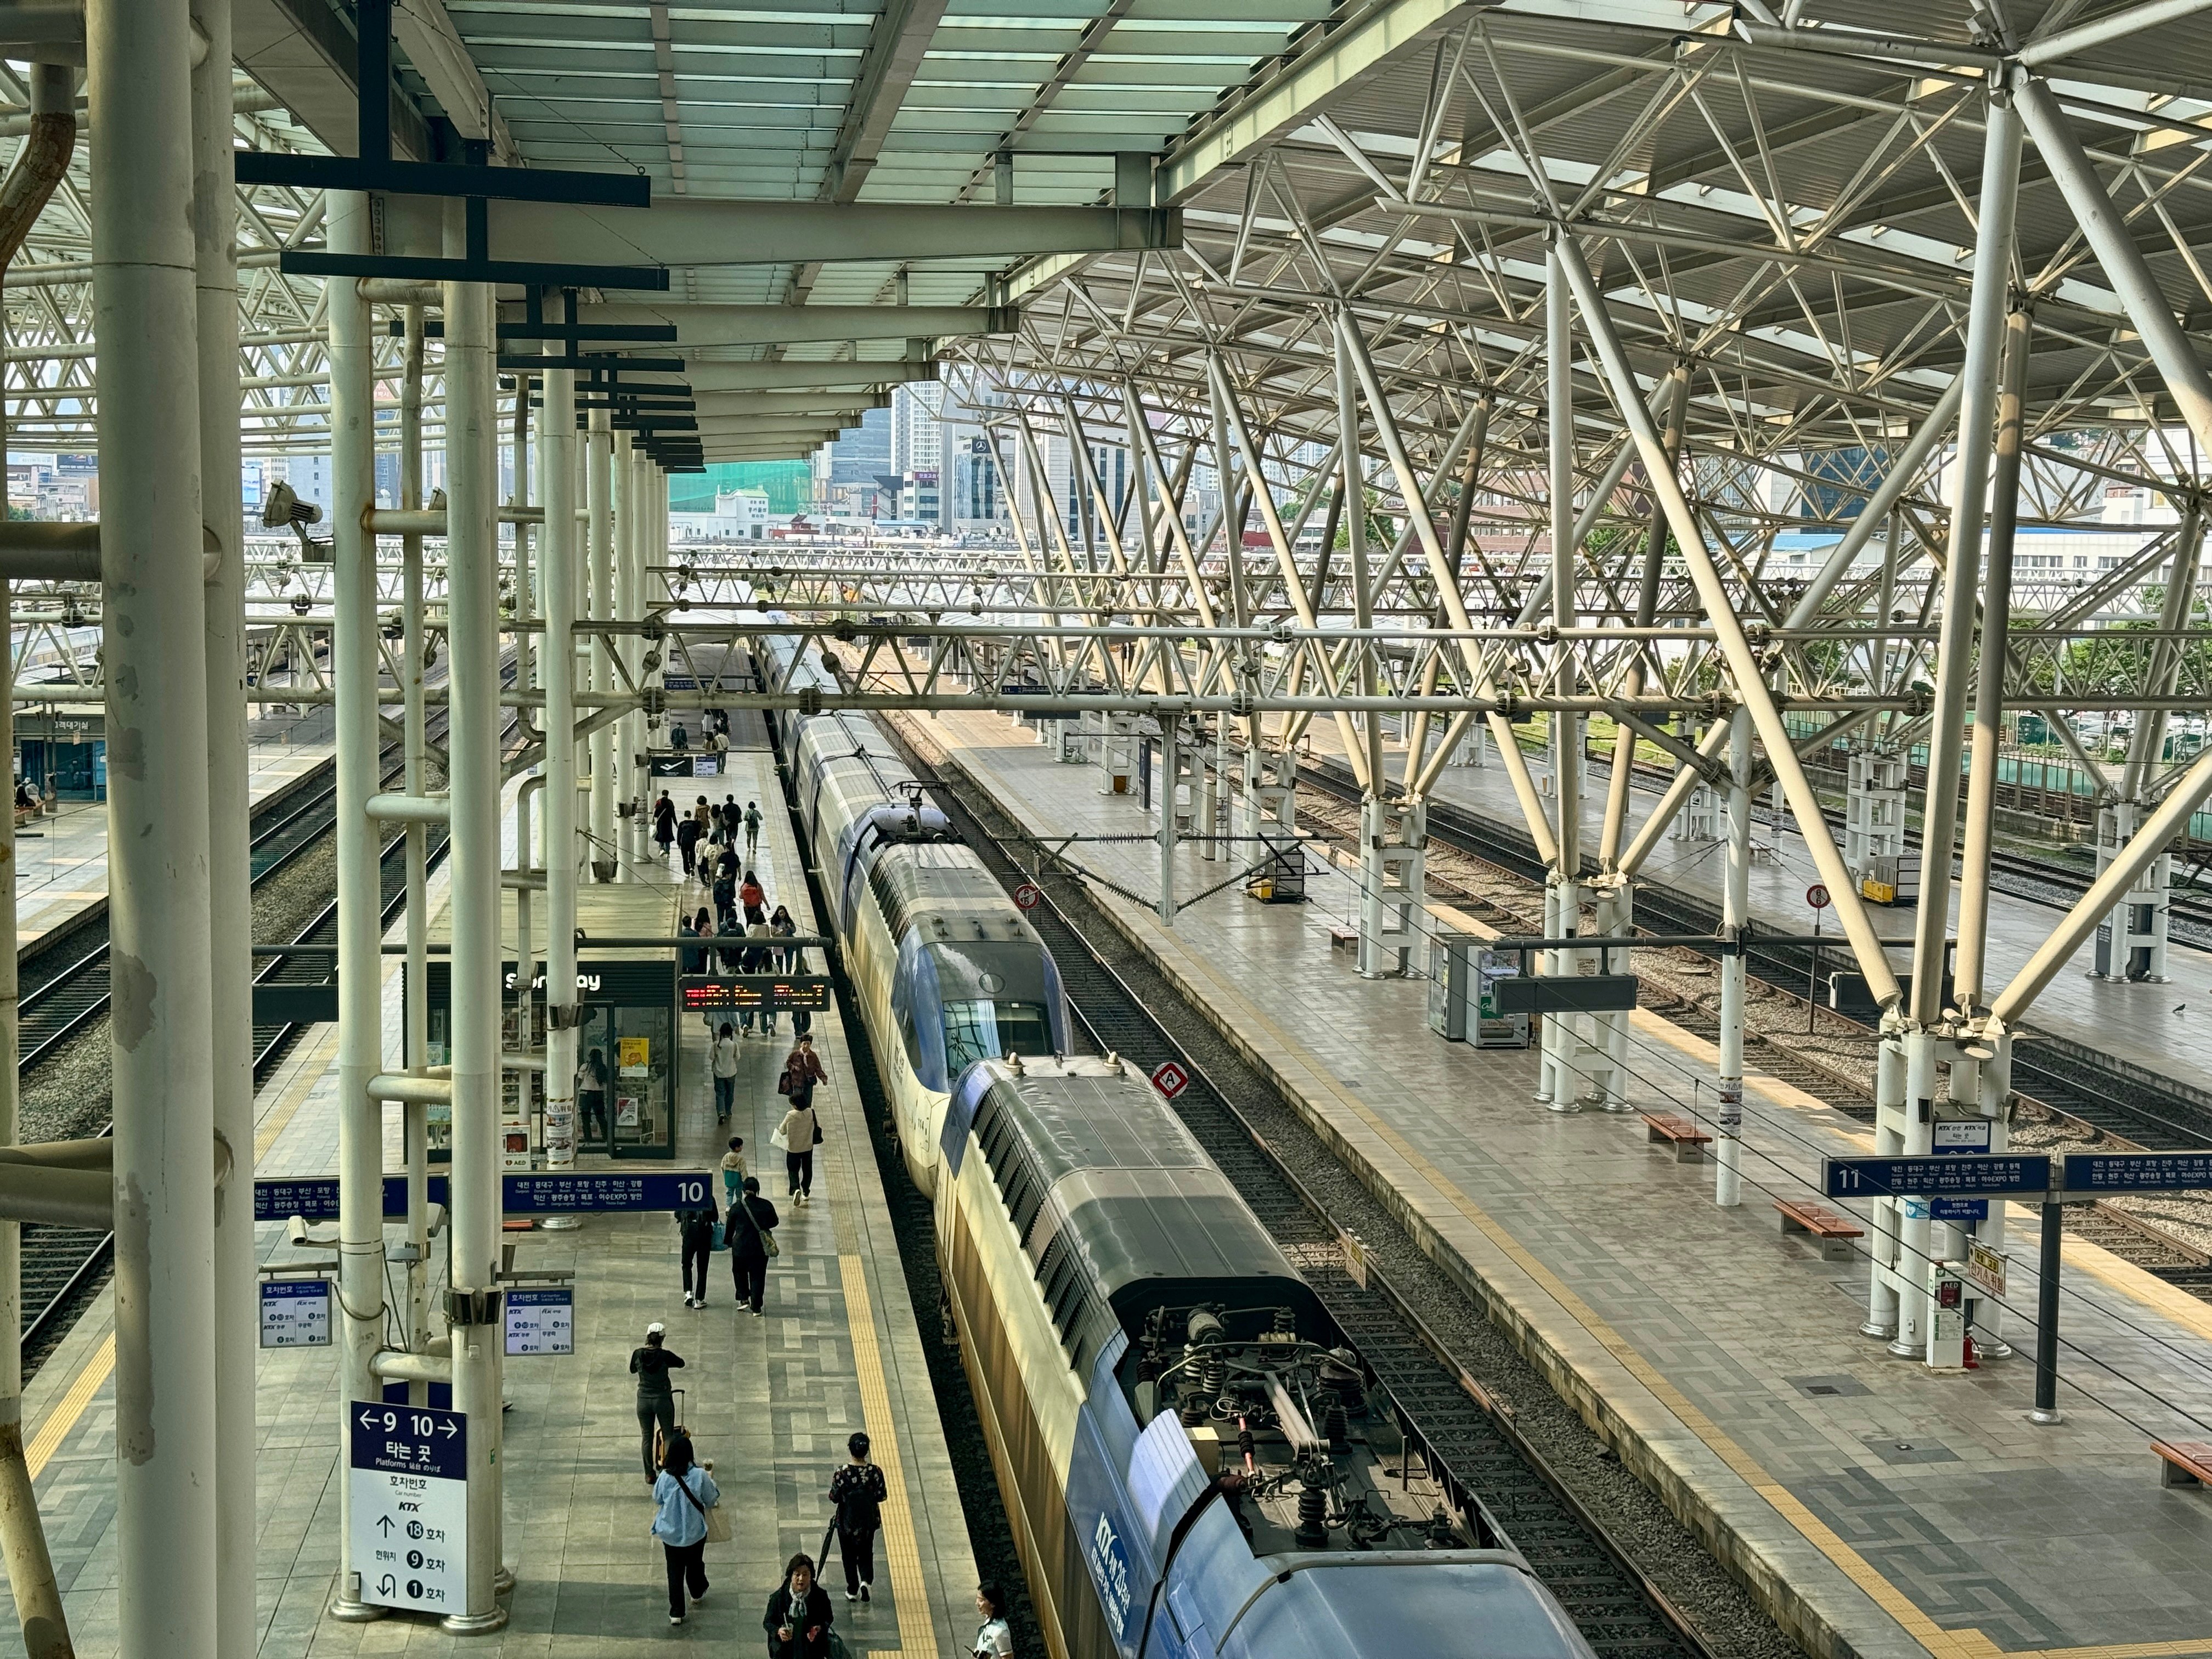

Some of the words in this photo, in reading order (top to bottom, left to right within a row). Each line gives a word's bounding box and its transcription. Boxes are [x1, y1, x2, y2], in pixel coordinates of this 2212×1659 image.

[506, 973, 600, 991] Sray
[1165, 1073, 1175, 1085] A
[517, 1181, 530, 1189] 대전
[535, 1181, 554, 1189] 동대구
[595, 1180, 607, 1188] 진주
[612, 1180, 625, 1188] 마산
[1839, 1169, 1860, 1189] 11
[1939, 1176, 1961, 1184] 광주송정
[255, 1188, 268, 1197] 대전
[274, 1188, 292, 1196] 동대구
[678, 1182, 703, 1202] 10
[274, 1201, 299, 1209] 광주송정
[1971, 1262, 1983, 1279] 전기
[1991, 1274, 2004, 1293] 위험
[266, 1285, 292, 1294] 호차번호
[383, 1412, 397, 1432] 9
[410, 1415, 433, 1437] 10
[386, 1441, 411, 1460] 타는
[417, 1444, 431, 1463] 곳
[375, 1457, 407, 1469] Platforms
[423, 1464, 441, 1473] のりば
[390, 1475, 427, 1491] 호차번호
[398, 1501, 424, 1513] KTX
[408, 1523, 422, 1537] 18
[426, 1527, 445, 1543] 호차
[1096, 1511, 1118, 1565] KTX
[376, 1550, 396, 1562] 현위치
[426, 1557, 445, 1573] 호차
[426, 1587, 445, 1602] 호차
